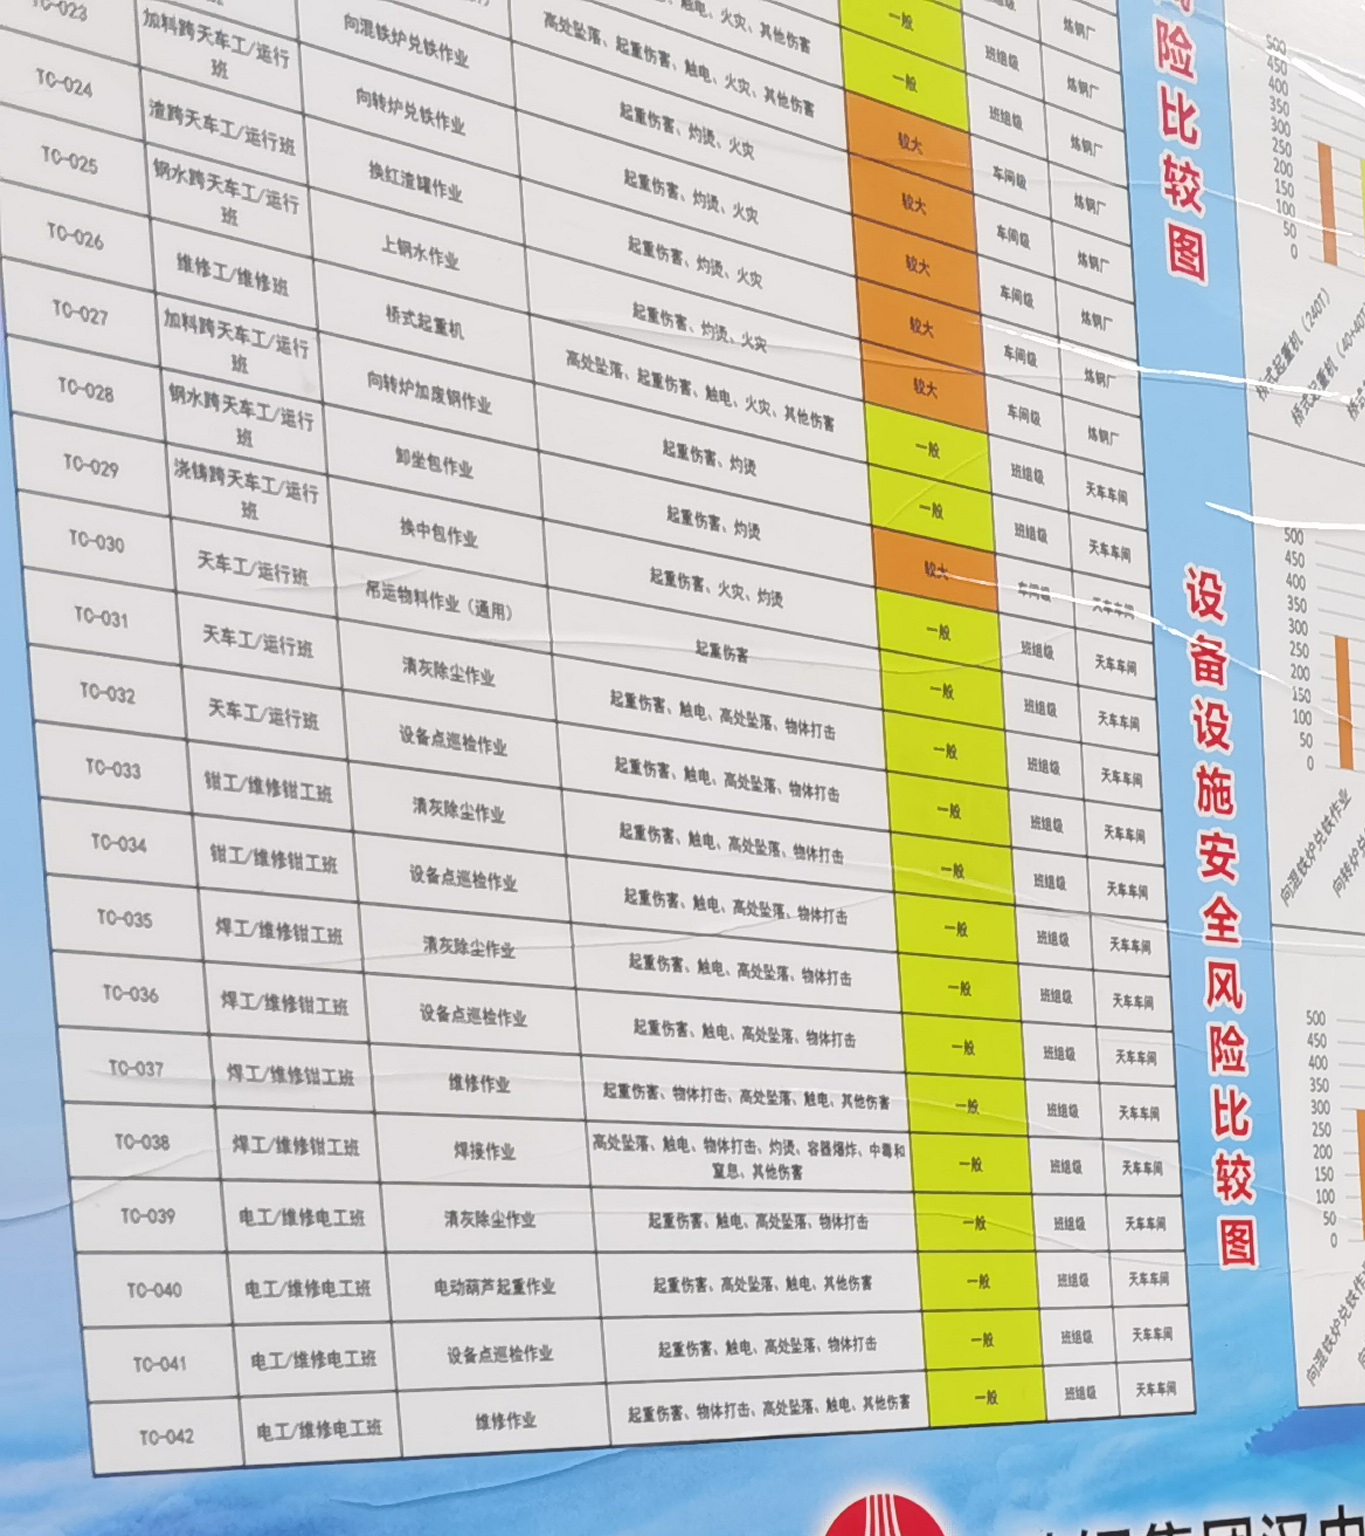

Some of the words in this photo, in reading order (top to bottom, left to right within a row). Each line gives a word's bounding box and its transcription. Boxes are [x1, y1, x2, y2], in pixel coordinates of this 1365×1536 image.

[343, 12, 470, 70] 向混铁炉兑铁作业
[35, 67, 93, 99] TC-024
[1066, 75, 1100, 99] 炼钢厂
[355, 86, 467, 137] 向转炉兑铁作业
[897, 131, 923, 155] 较大
[1156, 0, 1206, 282] 险比较图
[40, 144, 99, 176] TC-025
[368, 159, 464, 204] 换红渣罐作业
[992, 165, 1028, 191] 车间级
[46, 221, 105, 251] TC-026
[381, 234, 461, 272] 上钢水作业
[1076, 249, 1110, 274] 炼钢厂
[176, 251, 290, 298] 维修工/维修班
[52, 298, 109, 326] TC-027
[385, 303, 465, 341] 桥式起重机
[909, 315, 934, 339] 较大
[57, 375, 115, 404] TC-028
[366, 369, 493, 416] 向转炉加废钢作业
[63, 452, 120, 479] TC-029
[394, 445, 475, 480] 卸坐包作业
[68, 528, 126, 554] TC-030
[399, 516, 479, 550] 换中包作业
[1284, 527, 1304, 545] 500
[197, 549, 309, 588] 天车工/运行班
[1286, 572, 1306, 591] 400
[73, 605, 128, 629] TC-031
[1288, 618, 1308, 636] 300
[202, 623, 315, 659] 天车工/运行班
[693, 638, 752, 665] 起重伤害
[401, 655, 497, 688] 清灰除尘作业
[1291, 663, 1310, 681] 200
[79, 680, 136, 706] TC-032
[208, 696, 320, 732] 天车工/运行班
[1293, 709, 1312, 726] 100
[398, 723, 509, 758] 设备点巡检作业
[85, 756, 142, 780] TC-033
[1307, 756, 1314, 771] 0
[203, 769, 334, 805] 钳工/维修钳工班
[412, 795, 507, 825] 清灰除尘作业
[90, 832, 148, 854] TC-034
[209, 842, 339, 875] 钳工/维修钳工班
[408, 863, 519, 894] 设备点巡检作业
[96, 907, 153, 930] TC-035
[1187, 569, 1256, 1266] 设备设施安全风险比较图
[422, 934, 517, 960] 清灰除尘作业
[102, 983, 160, 1004] TC-036
[947, 980, 972, 997] 一般
[1039, 987, 1074, 1005] 班组级
[1112, 992, 1155, 1011] 天车车间
[419, 1002, 528, 1028] 设备点巡检作业
[1306, 1010, 1326, 1025] 500
[1307, 1033, 1327, 1048] 450
[108, 1058, 164, 1078] TC-037
[1308, 1055, 1328, 1070] 400
[447, 1072, 512, 1095] 维修作业
[1310, 1077, 1329, 1092] 350
[1311, 1100, 1330, 1115] 300
[1312, 1122, 1332, 1137] 250
[114, 1132, 171, 1152] TC-038
[453, 1140, 517, 1162] 焊接作业
[1313, 1144, 1333, 1159] 200
[1315, 1166, 1334, 1181] 150
[1316, 1189, 1335, 1204] 100
[120, 1207, 176, 1225] TC-039
[238, 1206, 366, 1228] 电工/维修电工班
[443, 1209, 537, 1230] 清灰除尘作业
[1323, 1211, 1337, 1226] 50
[1331, 1233, 1338, 1248] 0
[126, 1281, 183, 1299] TC-040
[244, 1278, 372, 1300] 电工/维修电工班
[433, 1276, 557, 1298] 电动葫芦起重作业
[970, 1331, 995, 1348] 一般
[1060, 1328, 1094, 1345] 班组级
[1132, 1325, 1174, 1343] 天车车间
[132, 1355, 187, 1373] TC-041
[250, 1348, 378, 1372] 电工/维修电工班
[446, 1343, 555, 1366] 设备点巡检作业
[256, 1417, 384, 1443] 电工/维修电工班
[474, 1410, 538, 1432] 维修作业
[138, 1427, 195, 1447] TC-042
